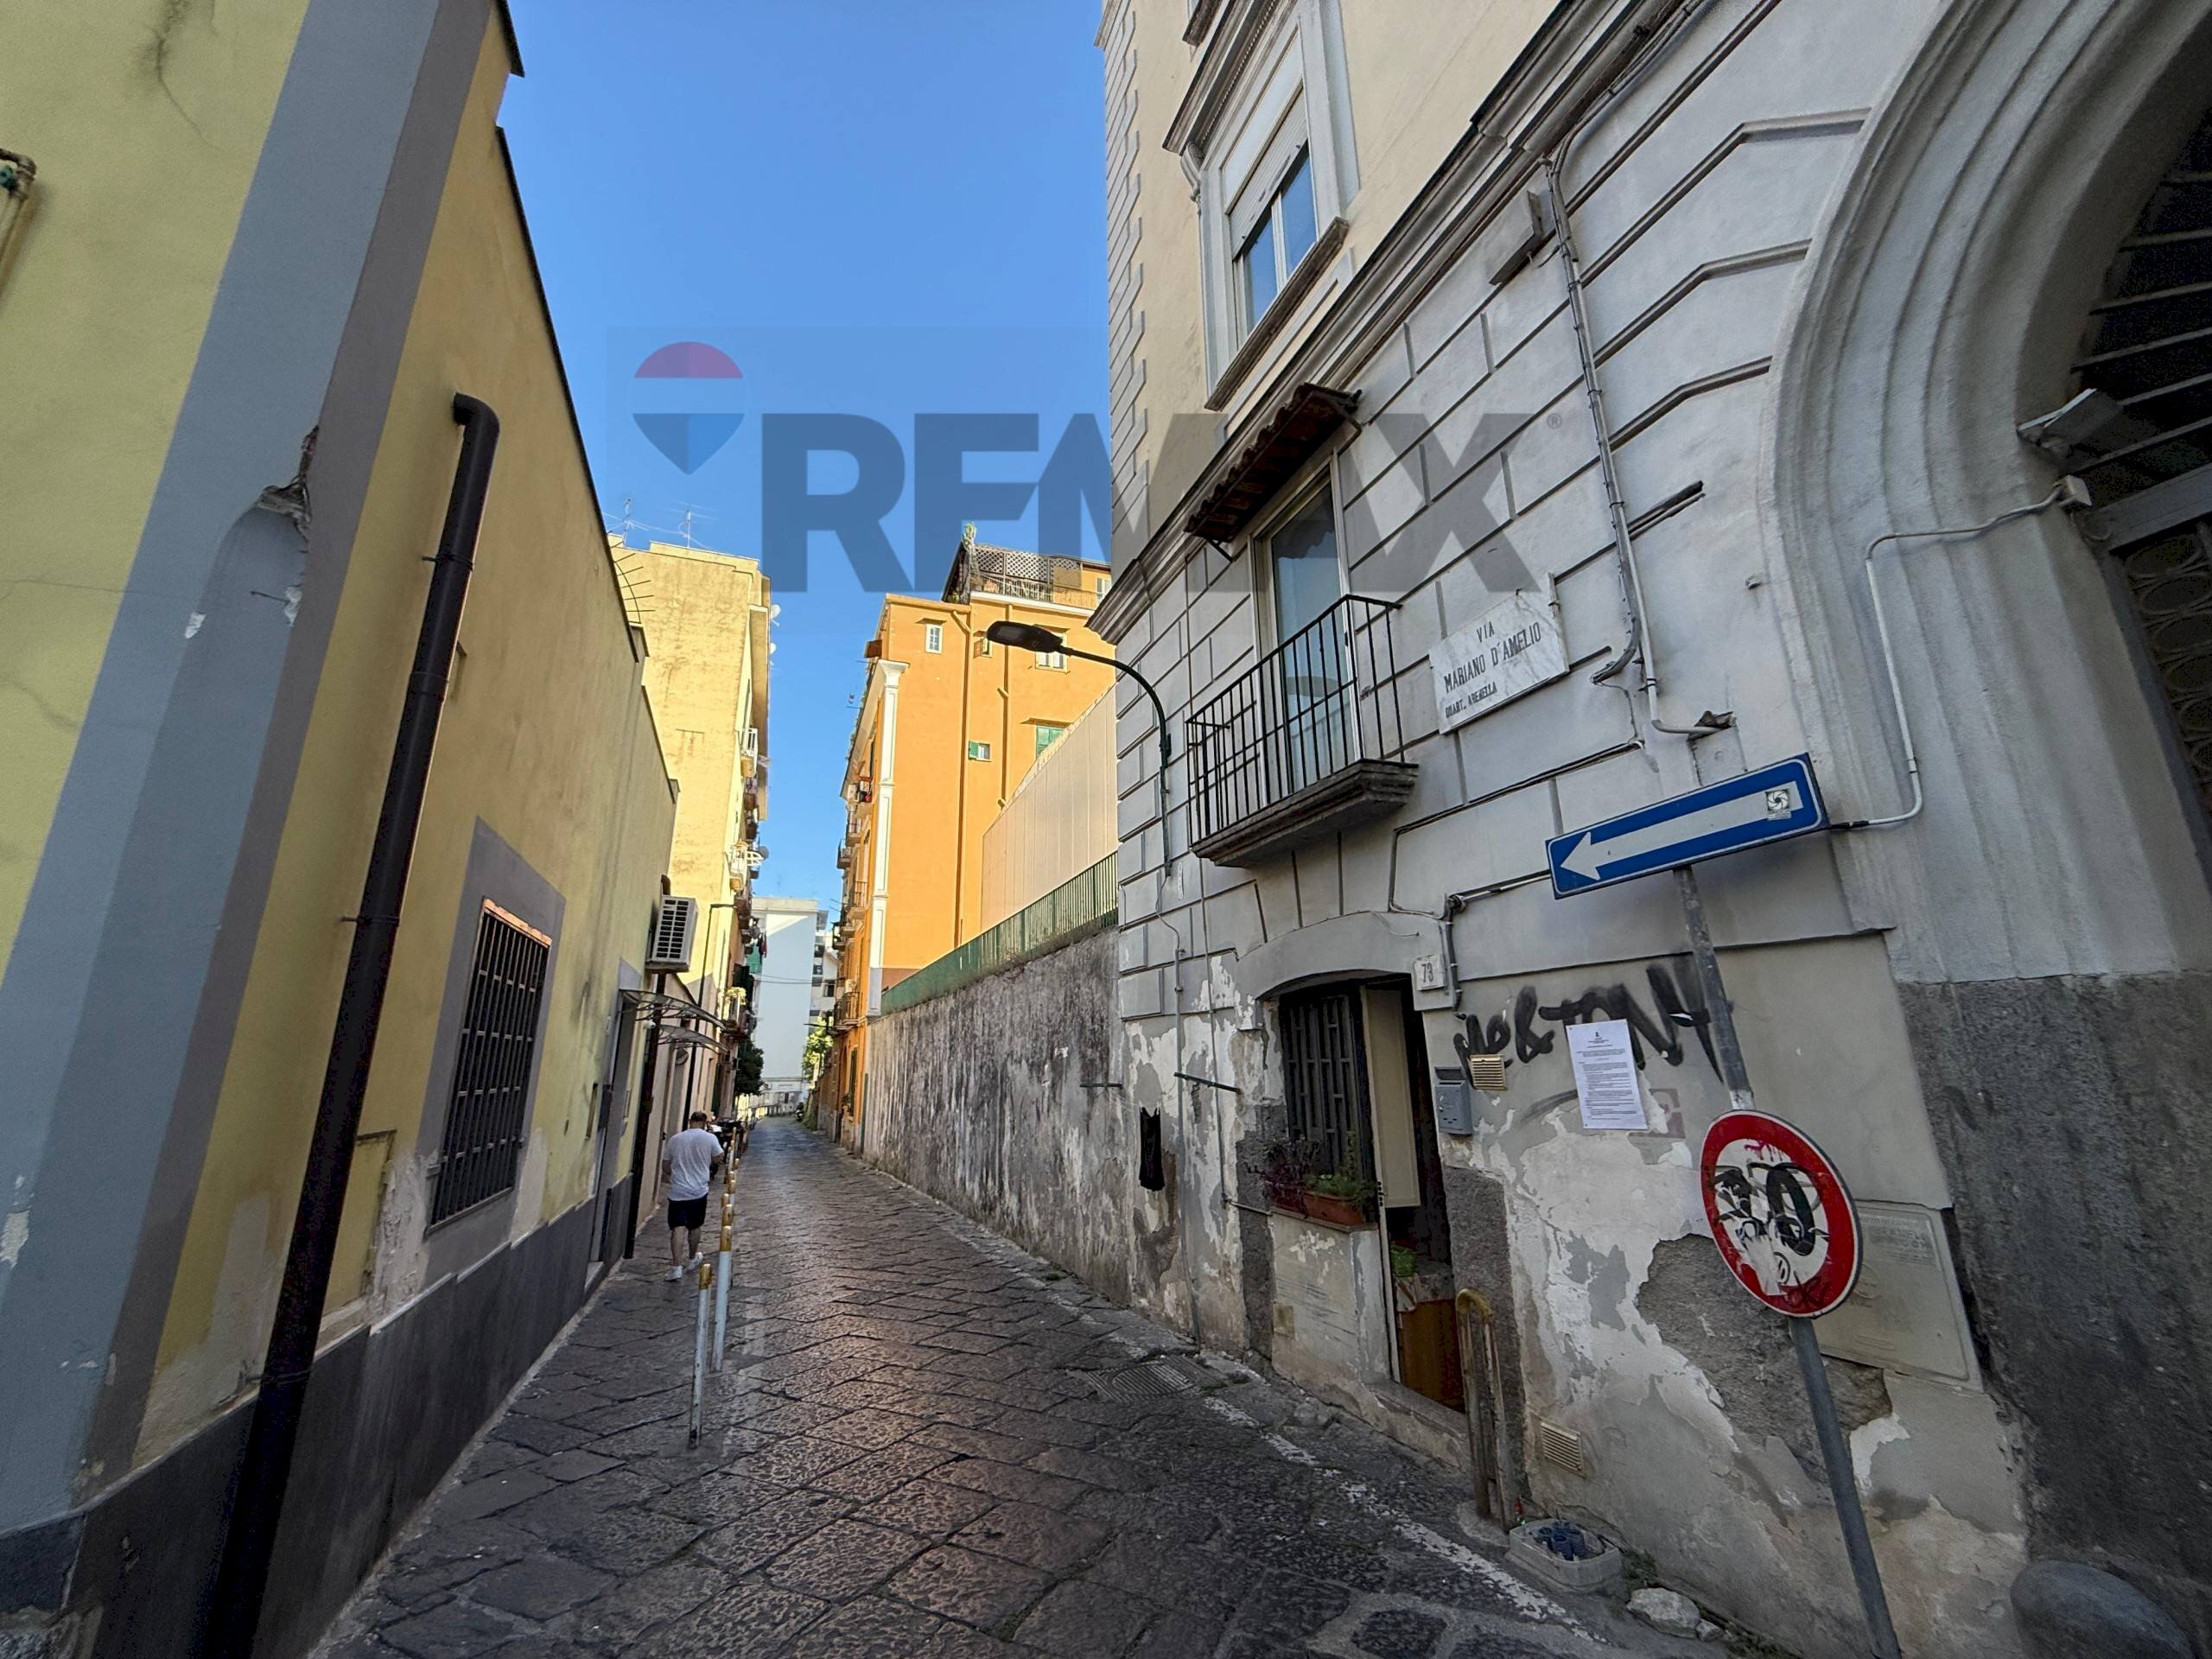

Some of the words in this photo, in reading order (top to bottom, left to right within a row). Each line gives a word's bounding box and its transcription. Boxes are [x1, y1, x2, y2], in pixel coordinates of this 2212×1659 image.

[1477, 621, 1495, 643] VIA
[1444, 654, 1486, 693] MARIANO
[1421, 962, 1434, 983] 73
